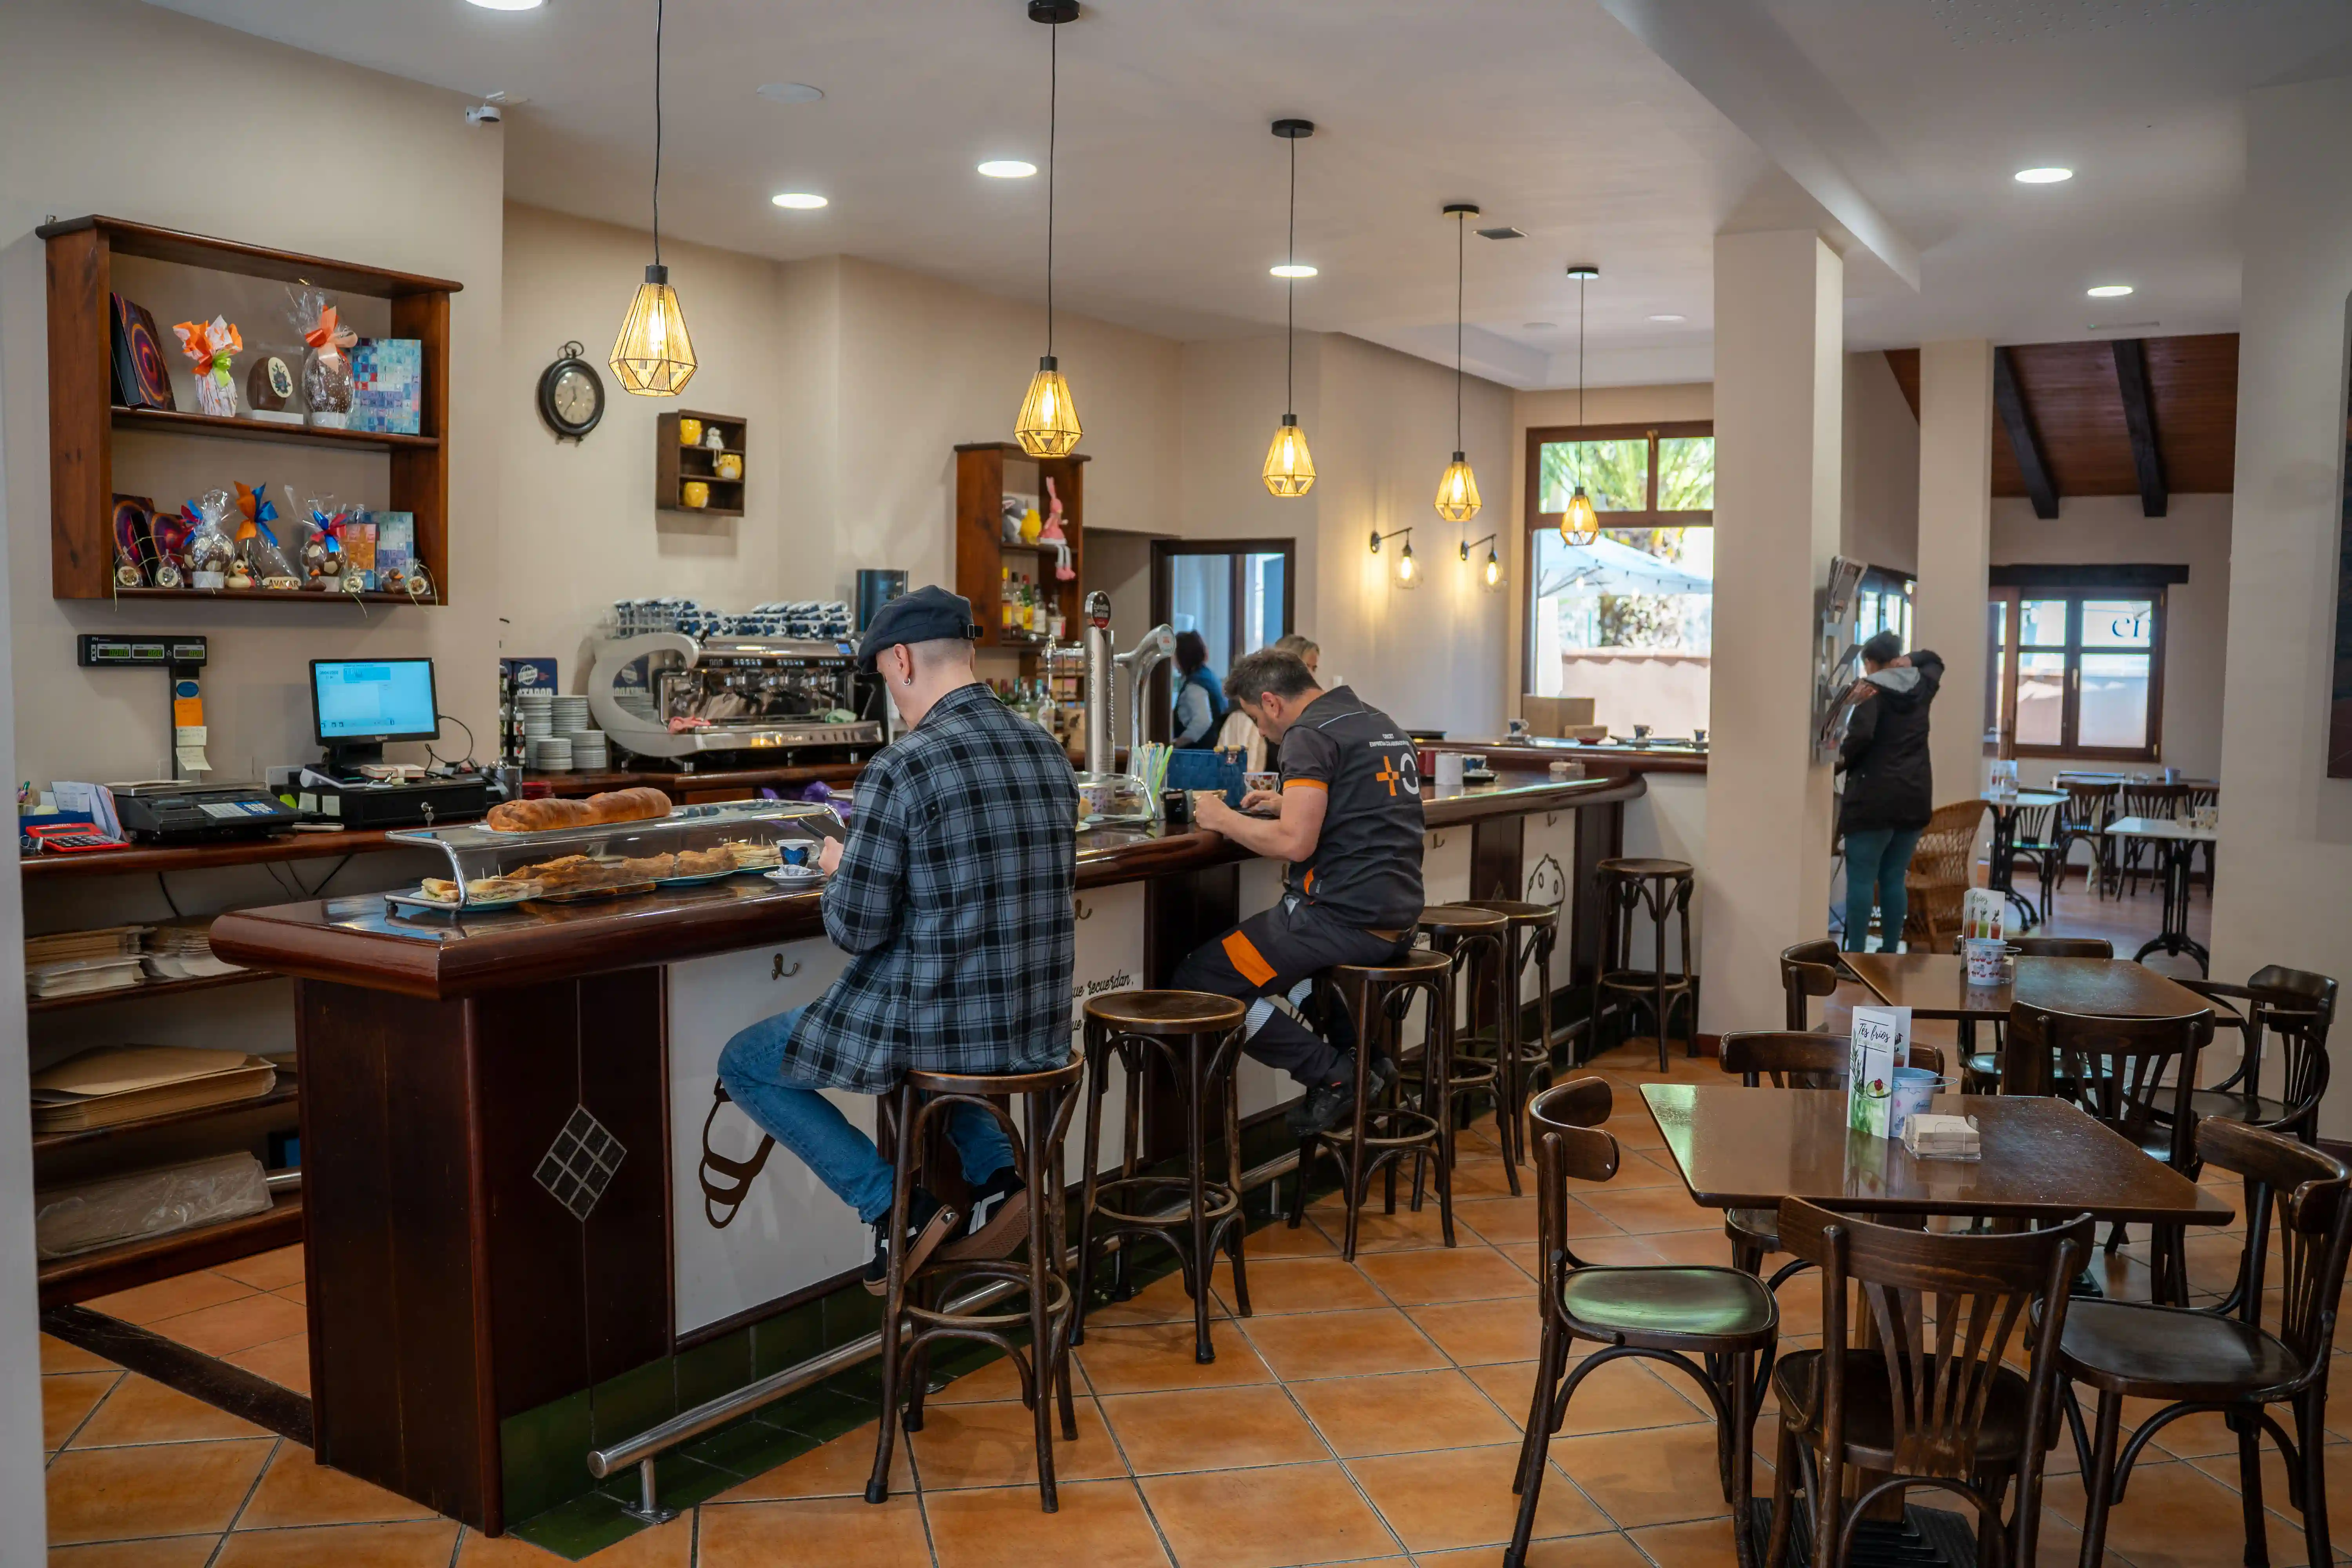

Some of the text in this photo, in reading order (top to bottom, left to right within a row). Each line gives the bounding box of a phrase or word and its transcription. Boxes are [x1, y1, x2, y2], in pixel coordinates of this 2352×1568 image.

[268, 579, 299, 588] AVATAR
[1087, 969, 1134, 996] recuerdan,
[1858, 1023, 1869, 1038] Tés
